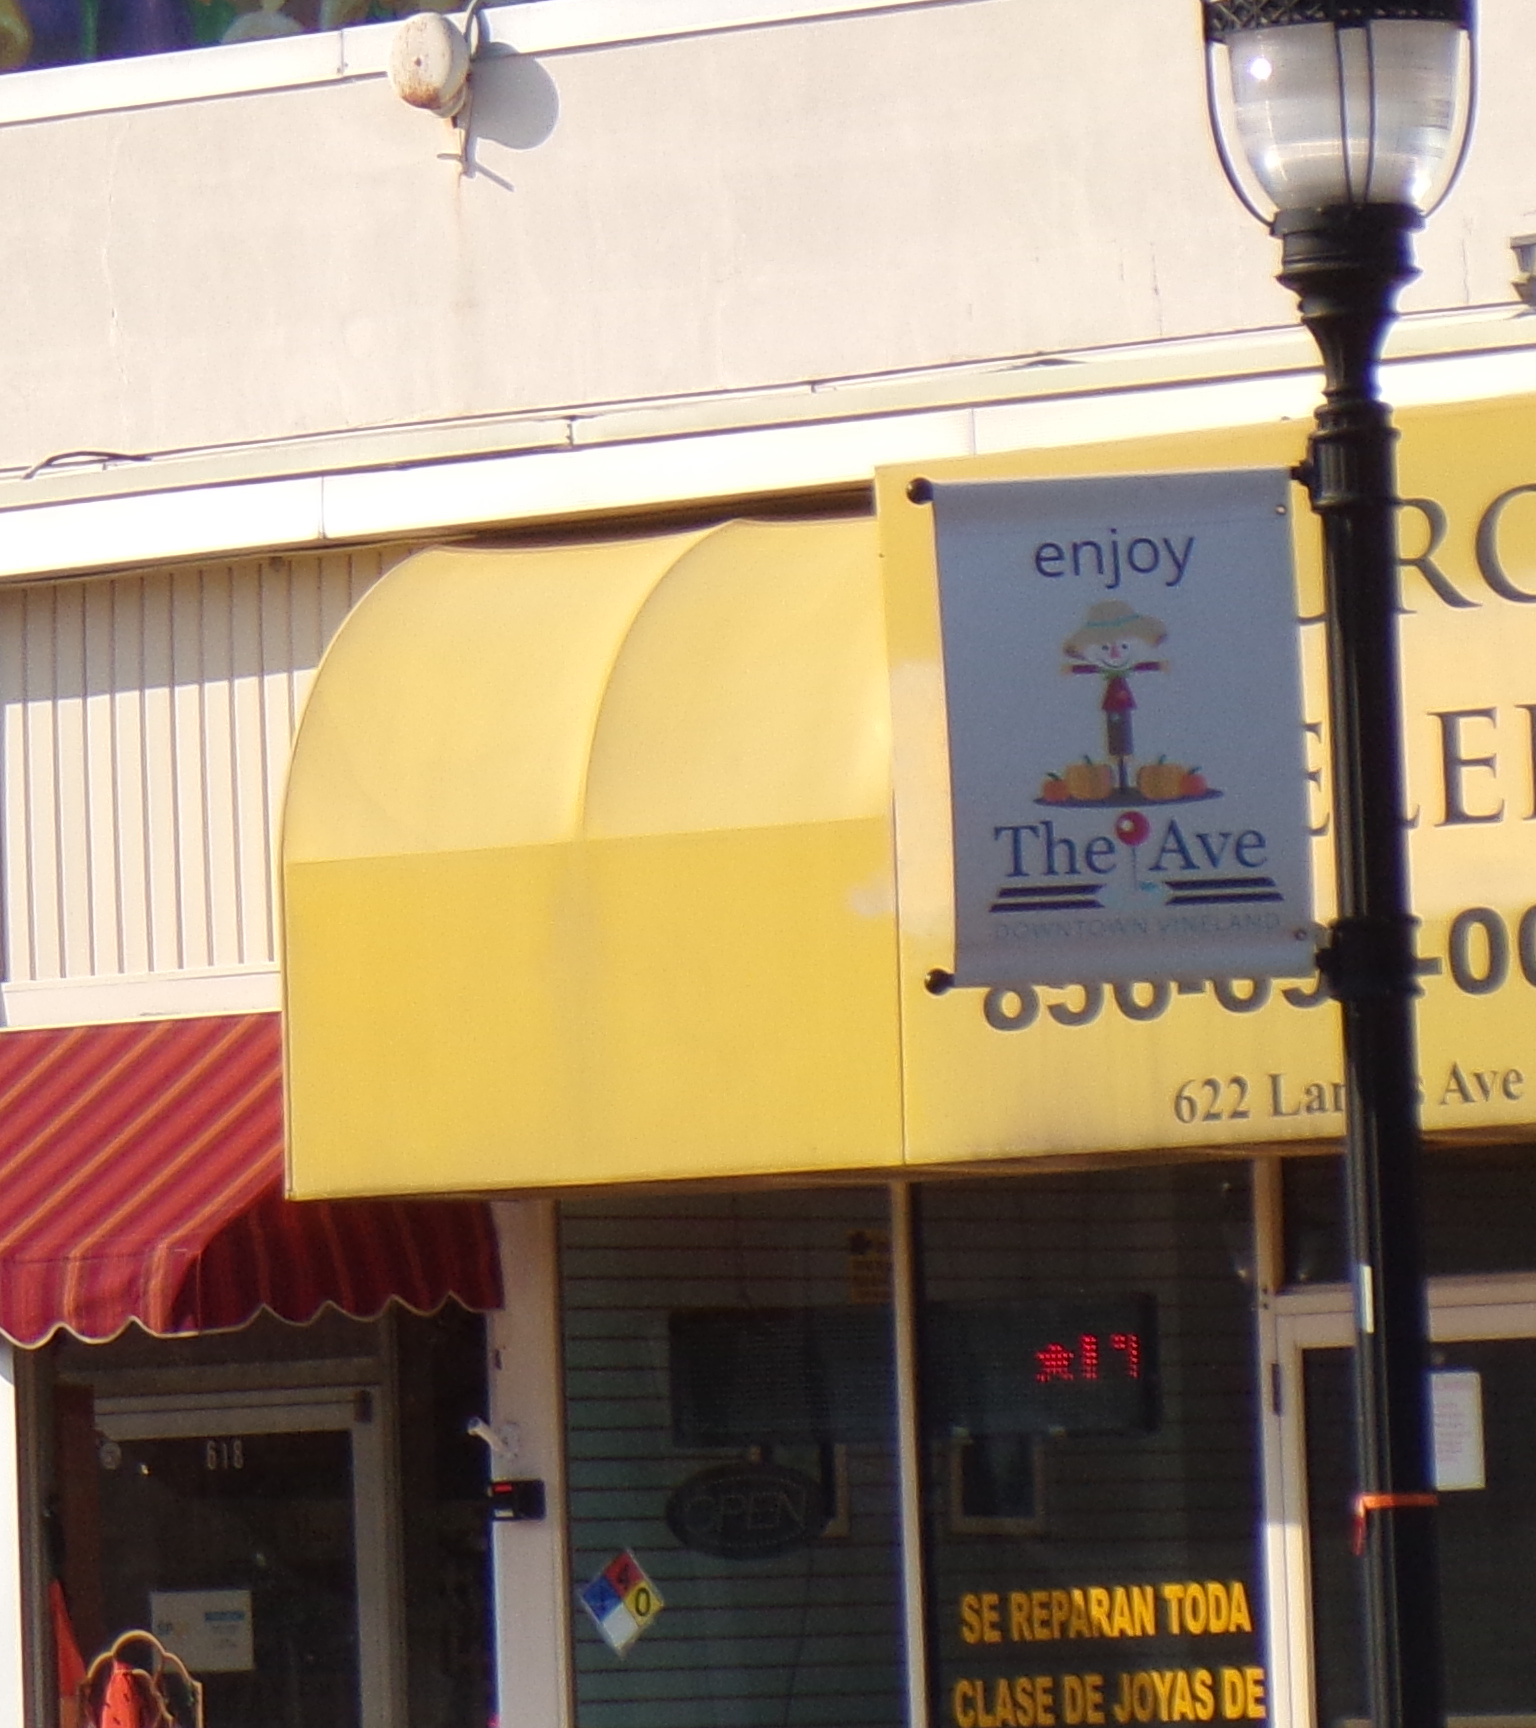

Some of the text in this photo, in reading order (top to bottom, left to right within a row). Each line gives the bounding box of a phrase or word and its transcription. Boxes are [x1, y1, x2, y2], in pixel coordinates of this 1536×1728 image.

[1034, 529, 1194, 589] enjoy
[994, 818, 1266, 878] The Ave
[1175, 1076, 1250, 1124] 622
[1439, 1061, 1524, 1106] Ave
[961, 1581, 1253, 1645] SE REPARAN TODA
[954, 1666, 1266, 1728] CLASE DE JOYAS DE
